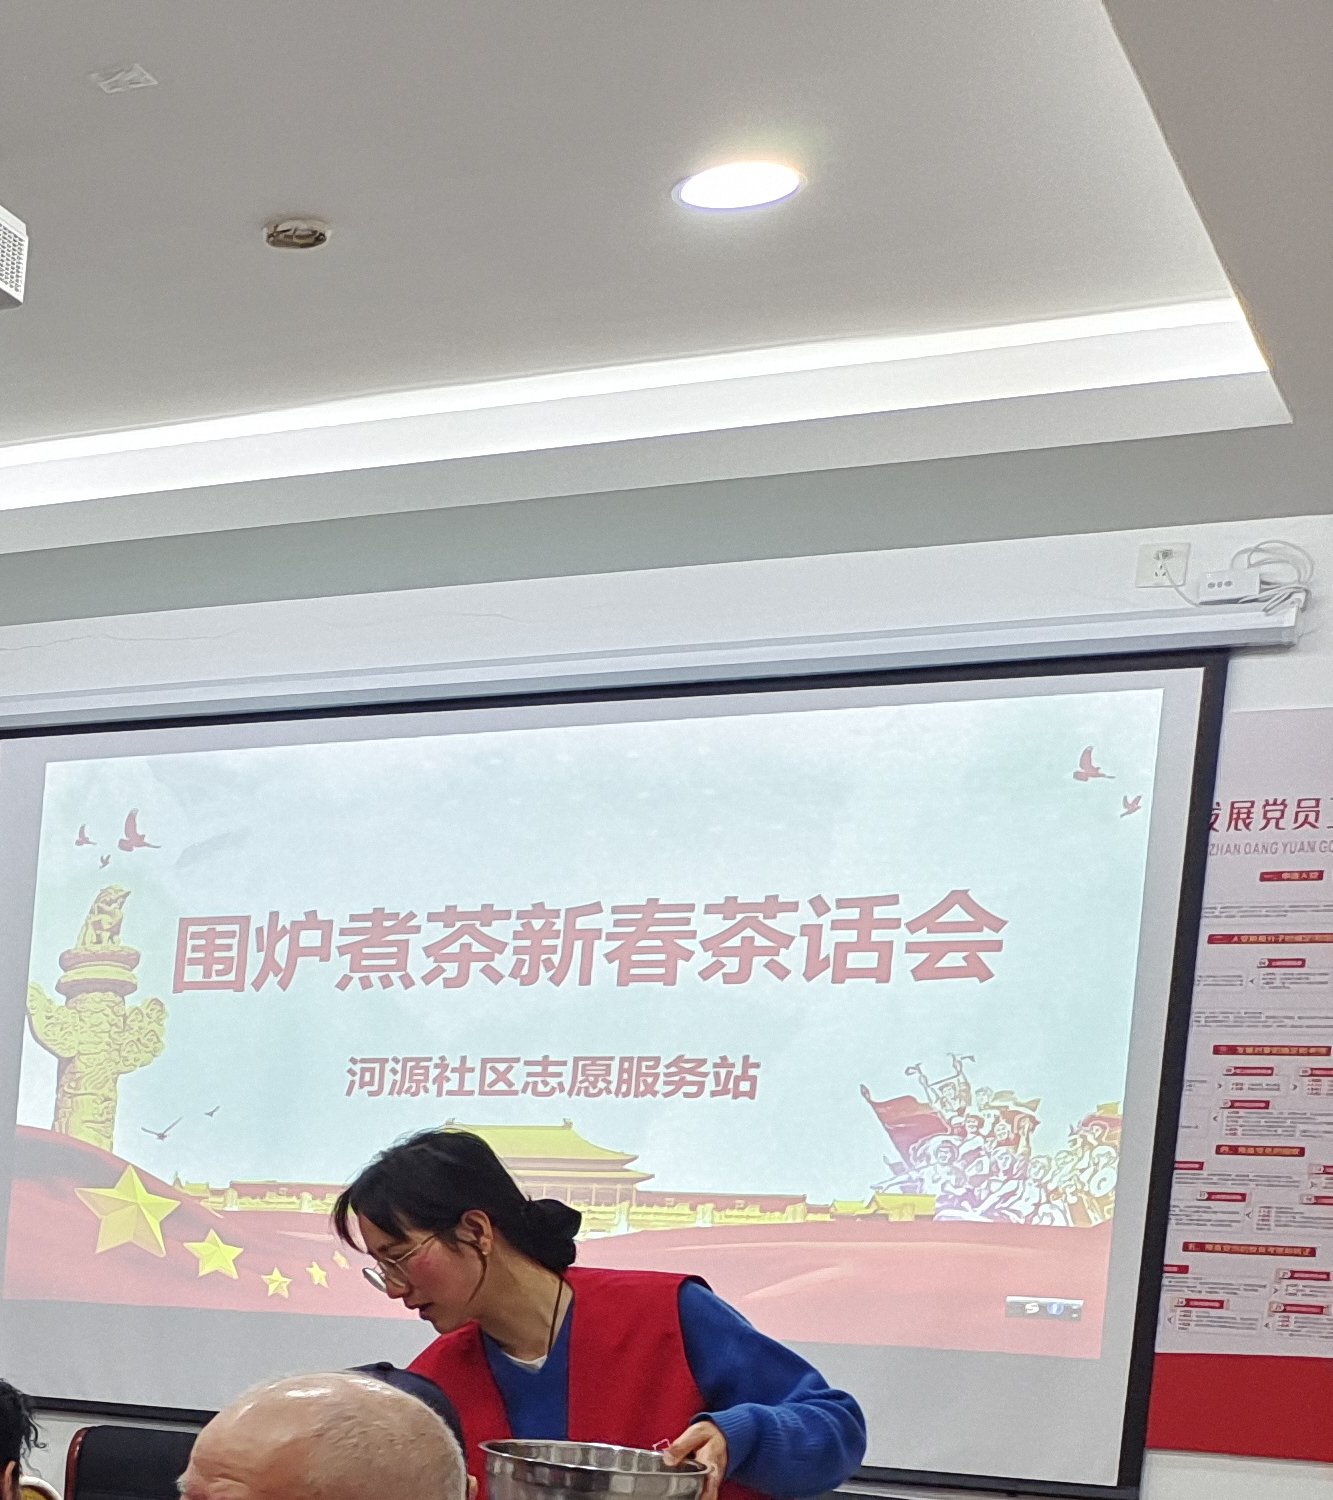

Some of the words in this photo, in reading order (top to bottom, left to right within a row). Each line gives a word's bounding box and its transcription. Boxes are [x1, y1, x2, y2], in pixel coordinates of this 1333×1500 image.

[1209, 797, 1333, 832] 展党员
[173, 888, 1009, 994] 围炉煮茶新春茶话会
[344, 1053, 761, 1101] 河源社区志愿服务站
